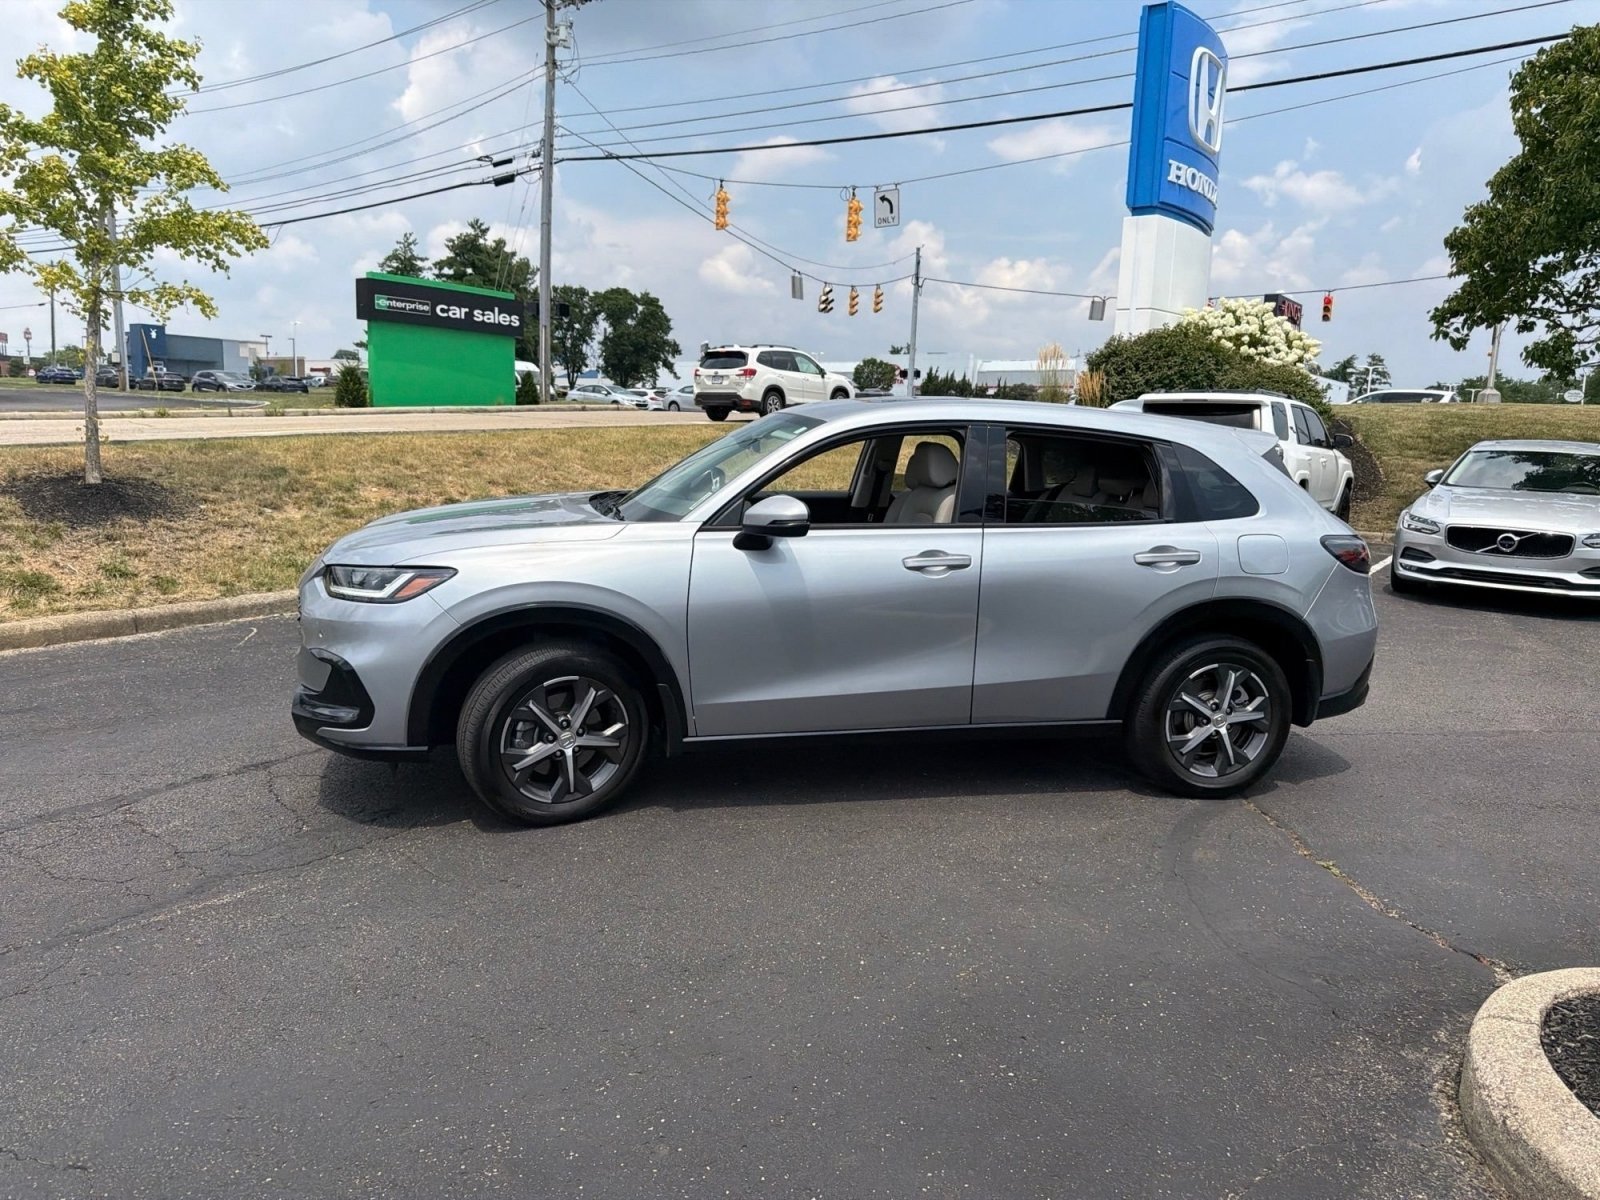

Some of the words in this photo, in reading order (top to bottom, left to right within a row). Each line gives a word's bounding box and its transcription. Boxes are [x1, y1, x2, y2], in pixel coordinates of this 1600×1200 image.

[1168, 159, 1218, 206] HOND
[877, 215, 896, 225] ONLY
[378, 297, 430, 312] enterprise
[435, 303, 470, 320] car
[473, 307, 520, 327] sales
